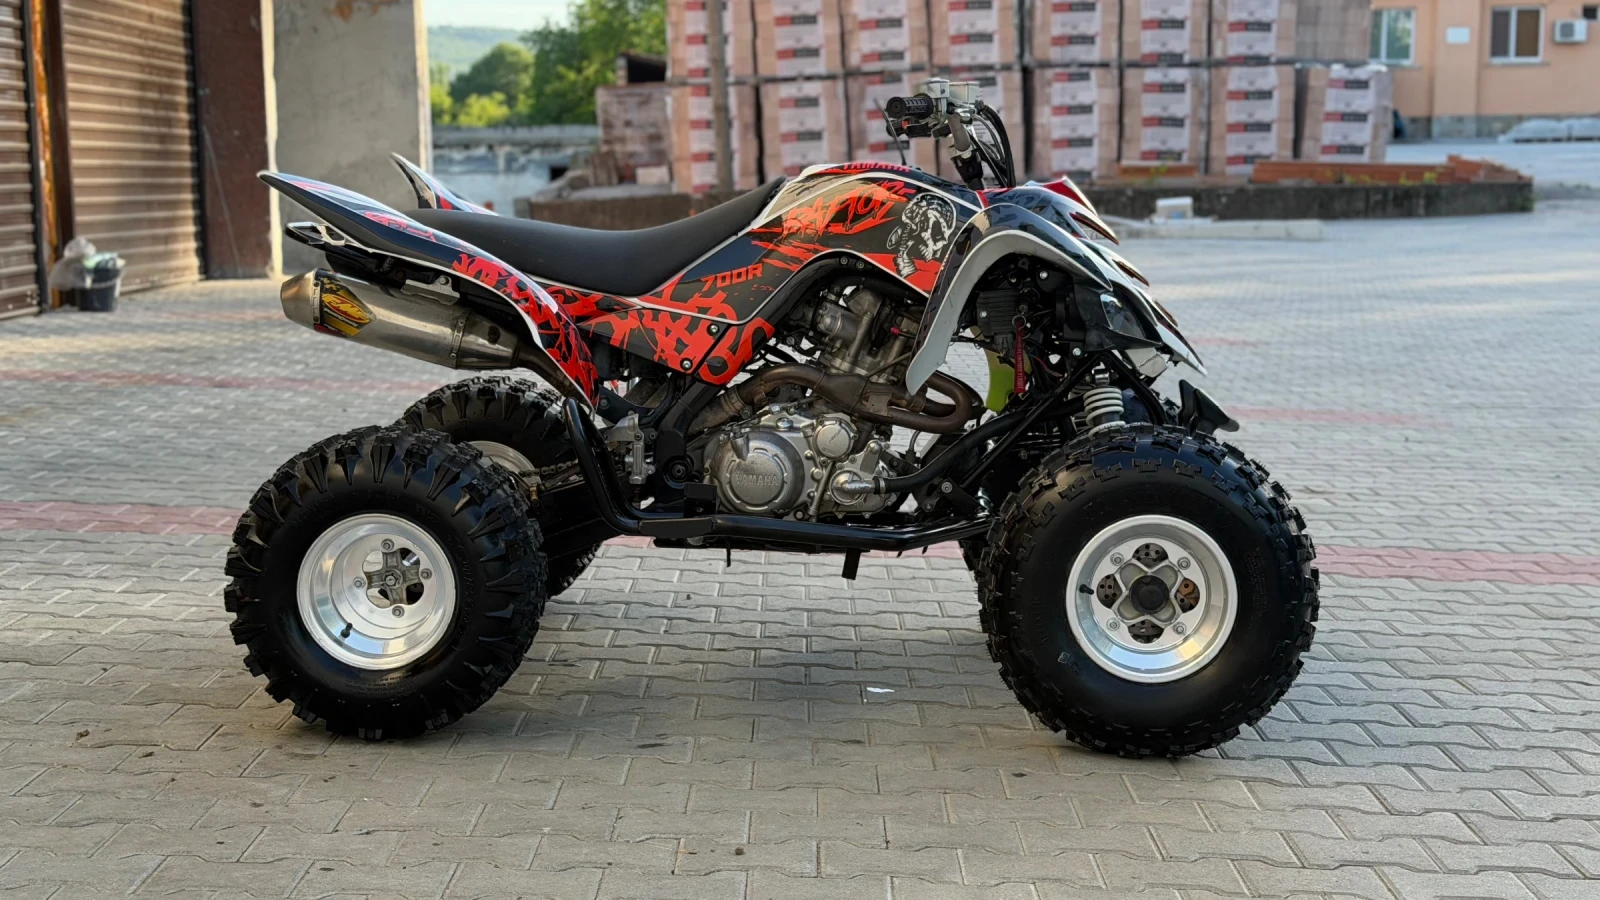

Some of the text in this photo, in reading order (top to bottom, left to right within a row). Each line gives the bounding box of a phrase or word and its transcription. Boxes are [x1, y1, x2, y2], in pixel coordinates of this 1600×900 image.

[843, 161, 910, 173] YAMAHA
[701, 262, 763, 292] 700R
[735, 472, 779, 486] YAMAHA
